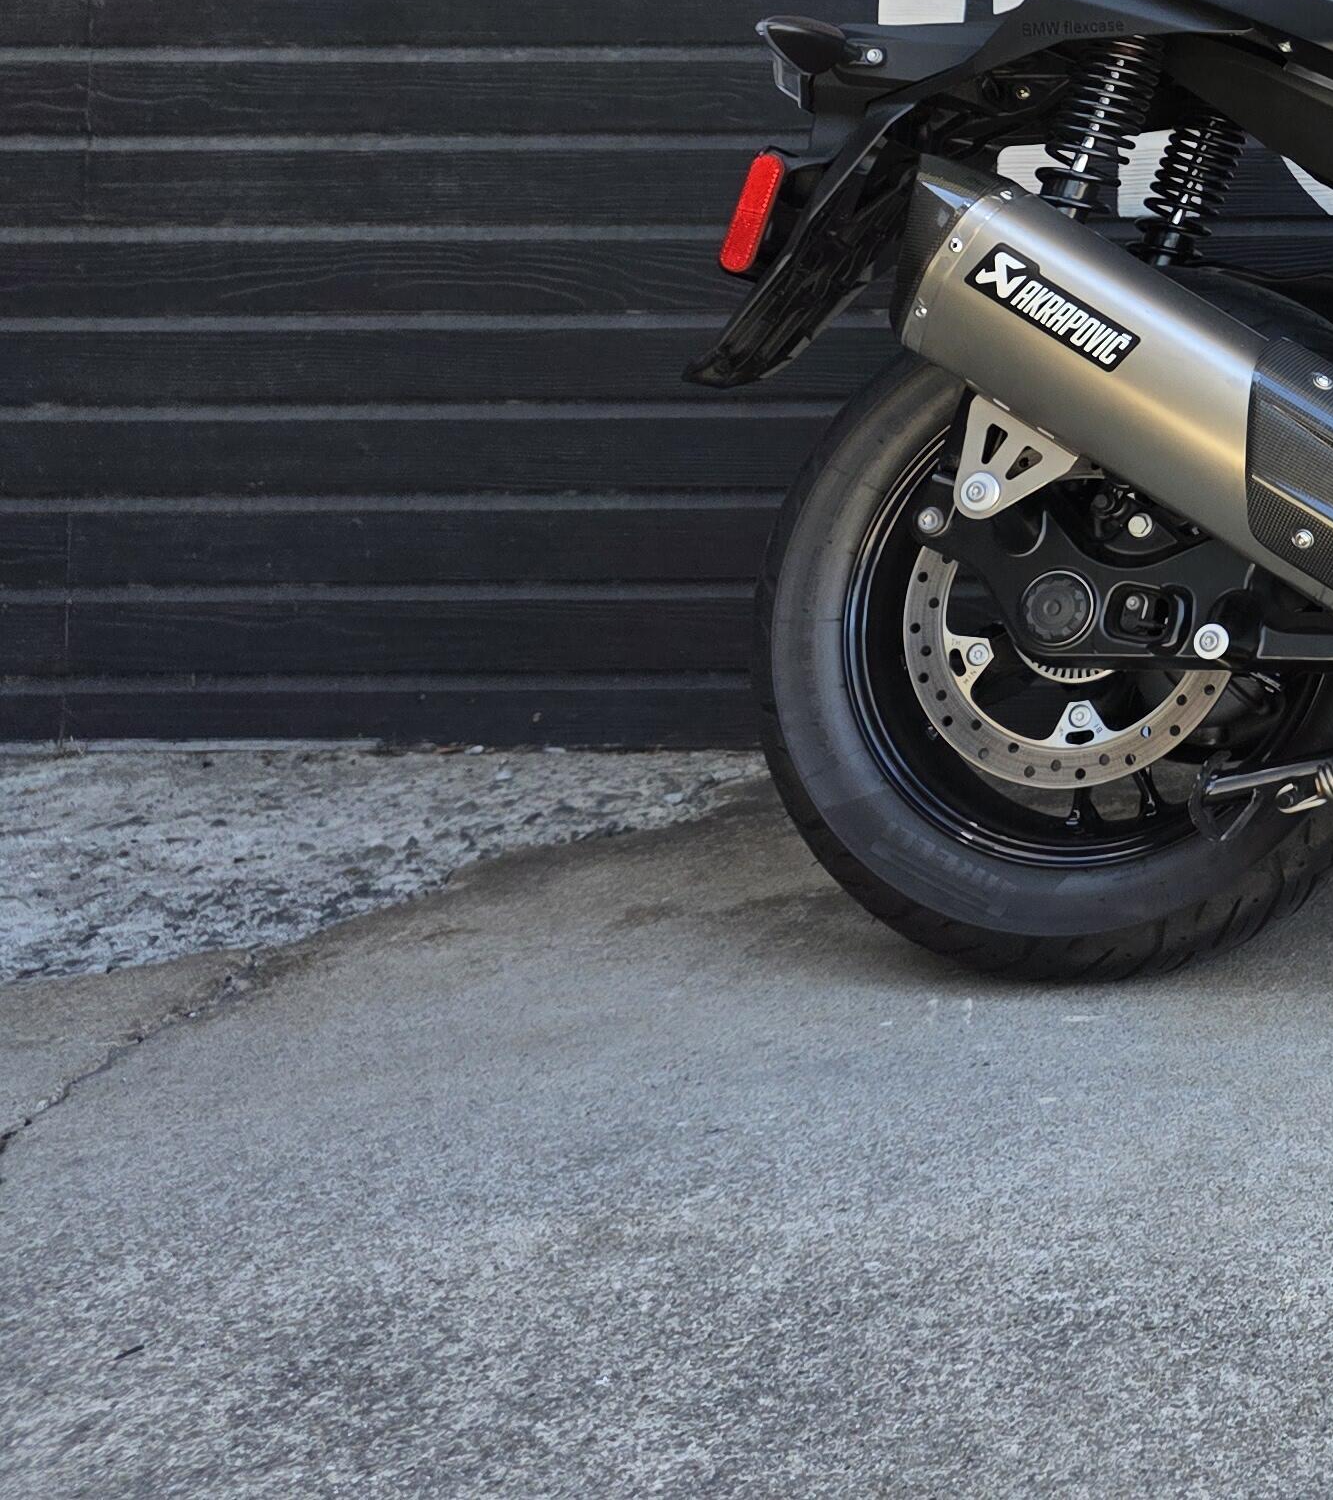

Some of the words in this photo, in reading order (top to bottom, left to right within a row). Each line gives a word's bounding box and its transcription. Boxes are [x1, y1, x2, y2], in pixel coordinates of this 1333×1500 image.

[1022, 21, 1059, 37] BMW
[1062, 20, 1125, 35] flexcase
[1009, 280, 1133, 365] AKRAPOVIČ
